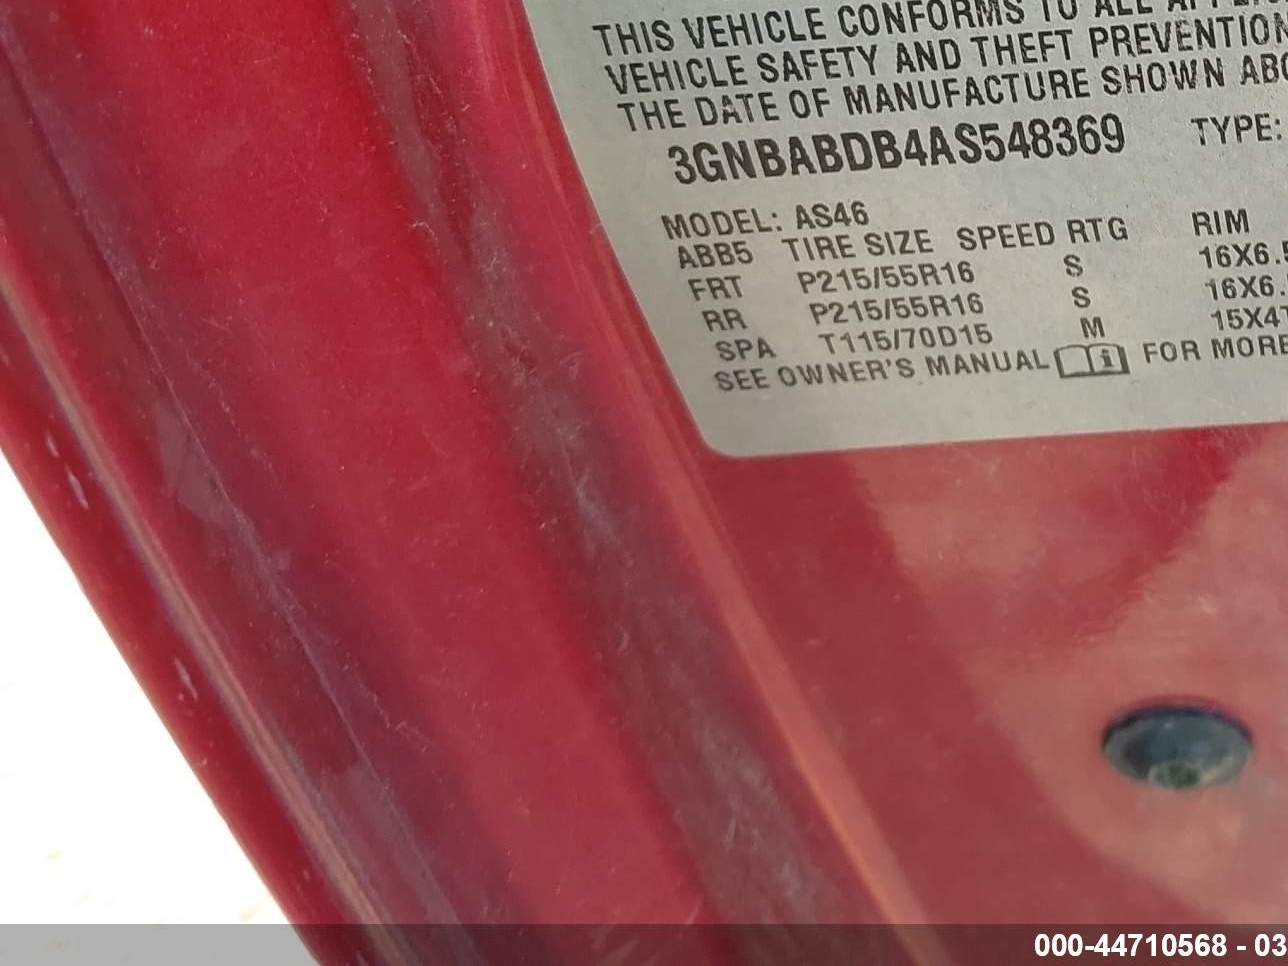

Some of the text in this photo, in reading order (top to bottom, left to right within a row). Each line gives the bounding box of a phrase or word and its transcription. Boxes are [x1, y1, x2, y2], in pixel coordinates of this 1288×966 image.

[593, 22, 675, 58] THIS
[686, 7, 826, 48] VEHICLE
[605, 55, 749, 95] VEHICLE
[757, 46, 879, 84] SAFETY
[895, 39, 963, 74] AND
[973, 31, 1075, 68] THEFT
[617, 100, 687, 133] THE
[699, 92, 780, 128] DATE
[791, 87, 831, 121] OF
[844, 69, 1090, 118] MANUFACTURE
[1102, 57, 1225, 96] SHOWN
[1191, 113, 1282, 146] TYPE:
[668, 114, 1125, 185] 3GNBABDB4AS548369
[661, 201, 869, 241] MODEL: AS46
[1192, 204, 1251, 236] RIM
[677, 217, 1128, 270] ABB5 TIRE SIZE SPEED RTG
[799, 261, 975, 294] P215/55R16
[1065, 253, 1084, 278] S
[688, 276, 744, 302] FRT
[1072, 285, 1091, 309] S
[702, 307, 748, 332] RR
[809, 292, 984, 325] P215/55R16
[818, 323, 993, 356] T115/70D15
[1079, 316, 1105, 339] M
[713, 368, 770, 393] SEE
[778, 354, 915, 388] OWNER'S
[926, 347, 1051, 377] MANUAL
[1143, 339, 1201, 364] FOR
[716, 339, 777, 363] SPA
